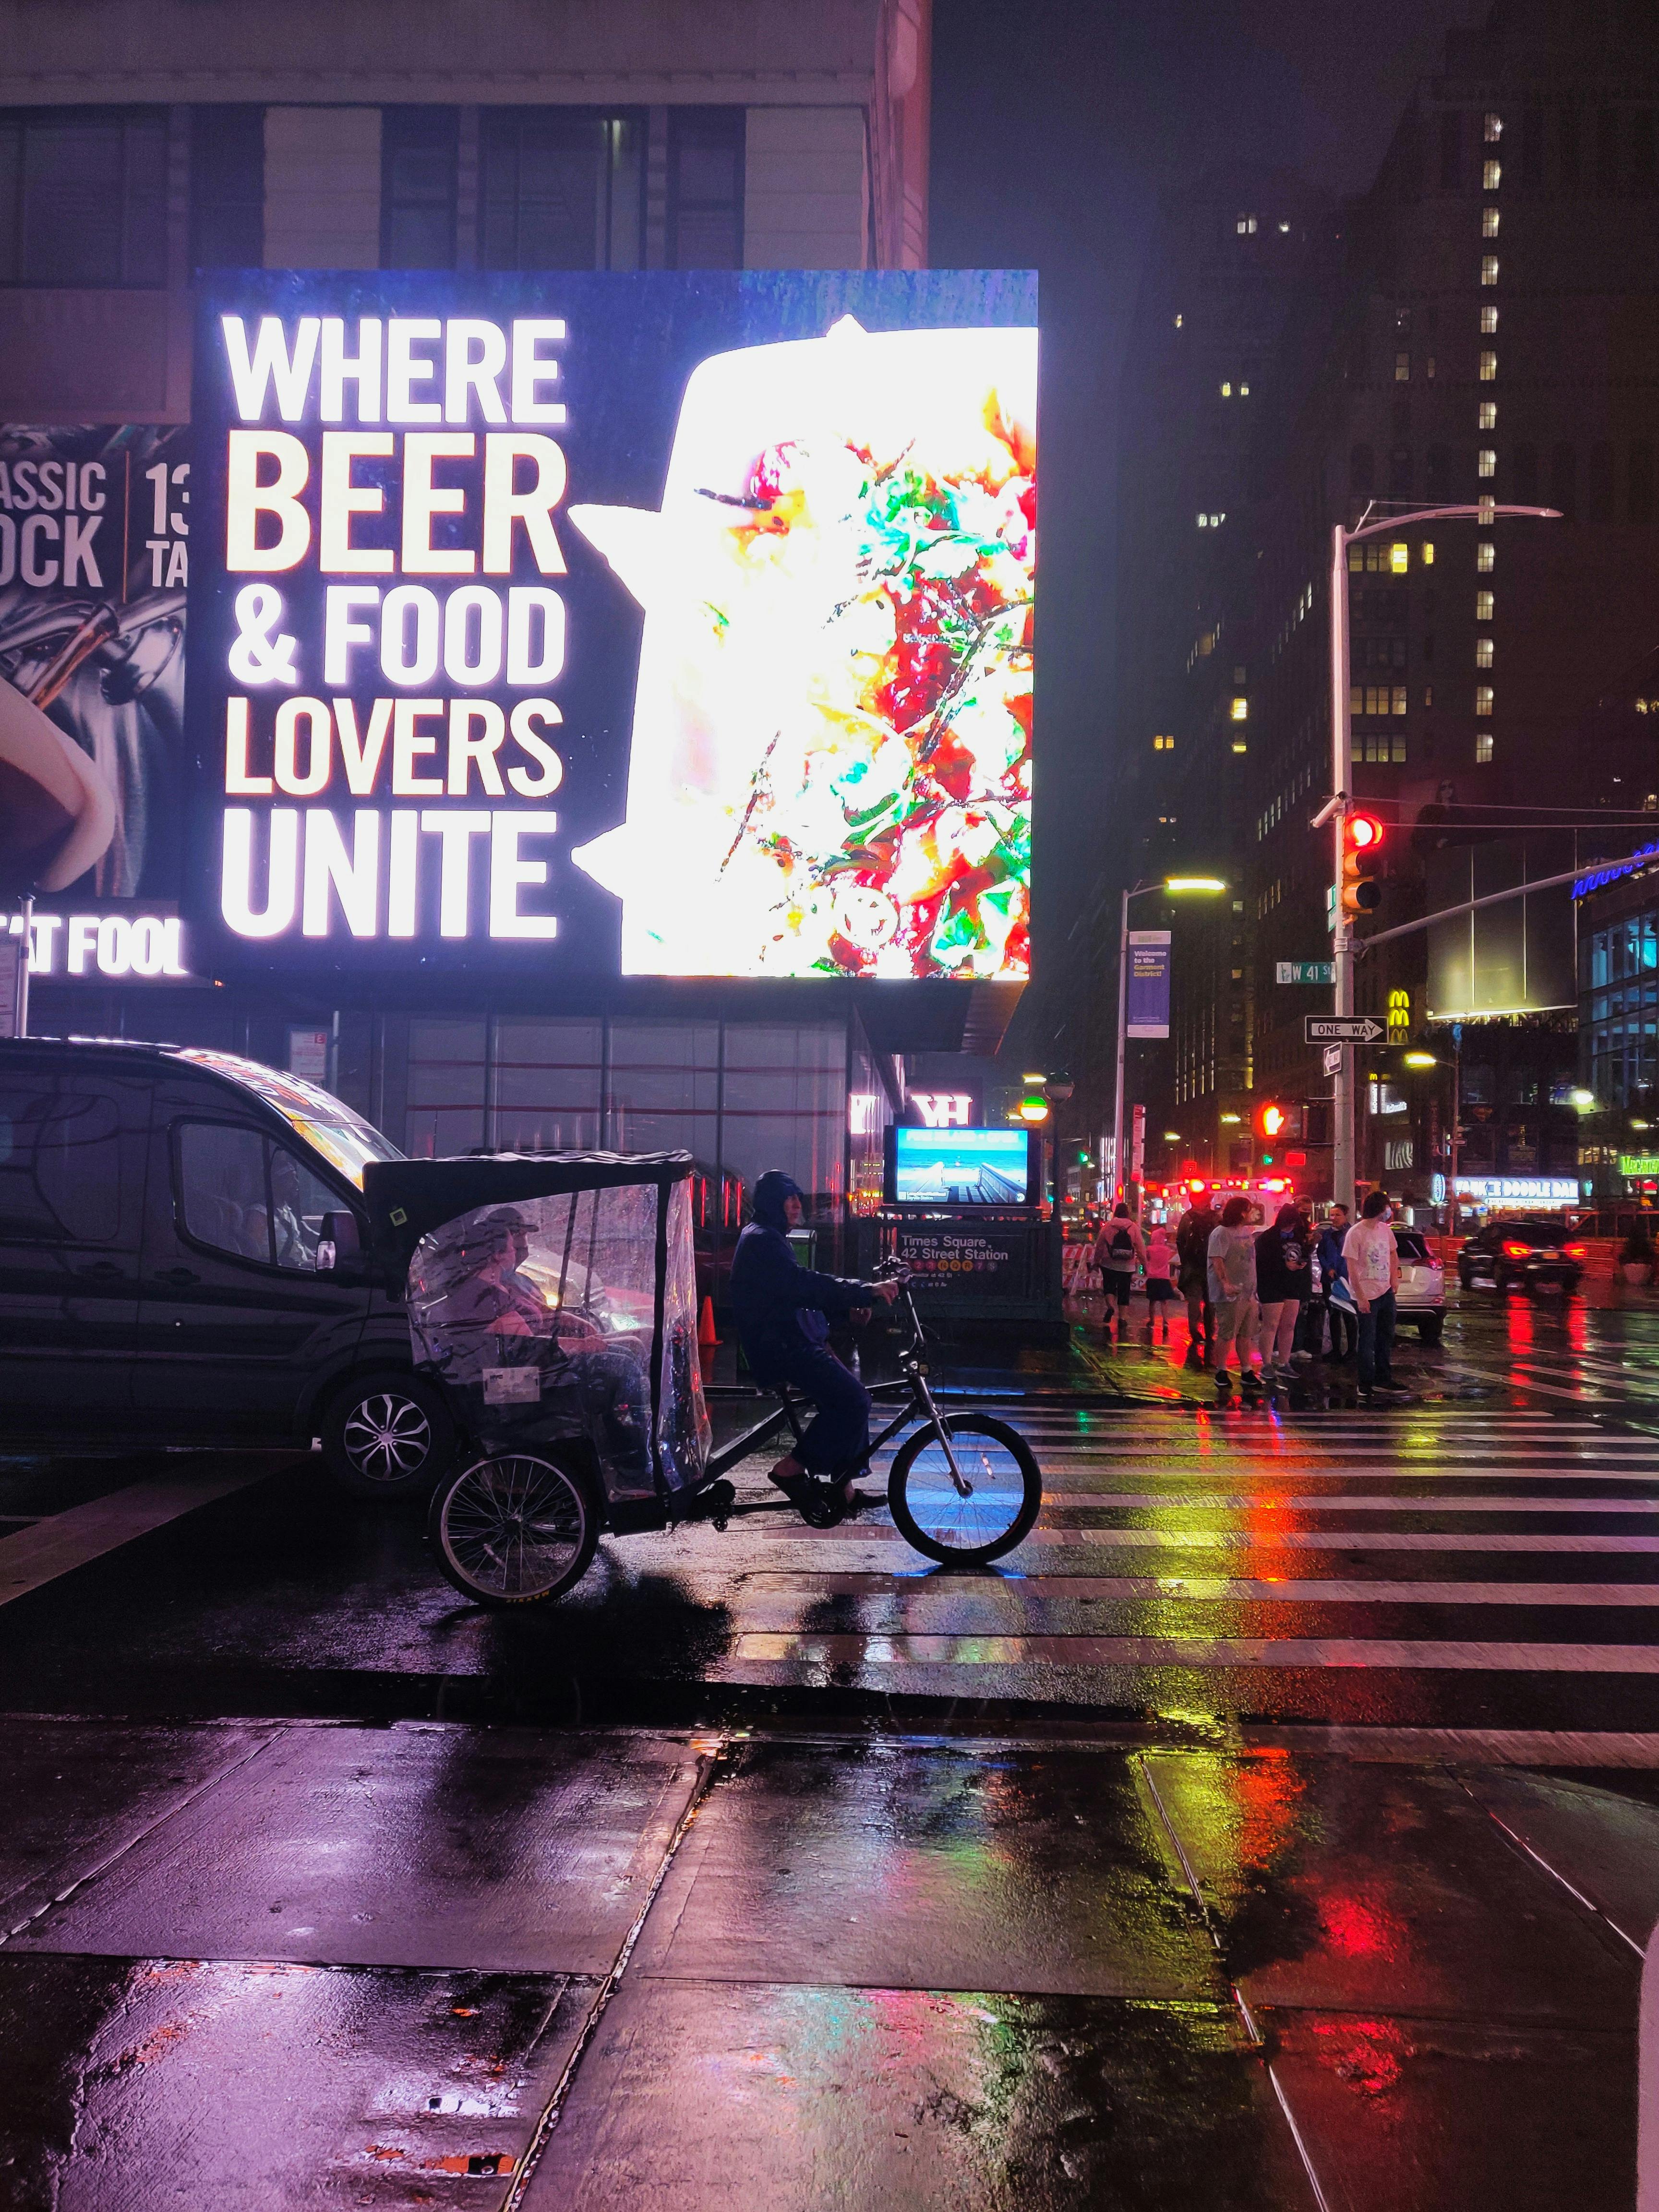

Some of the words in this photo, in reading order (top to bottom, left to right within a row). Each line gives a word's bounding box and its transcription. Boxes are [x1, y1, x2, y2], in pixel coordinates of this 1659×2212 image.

[222, 317, 566, 423] WHERE
[226, 430, 567, 574] BEER
[228, 583, 297, 685] &
[324, 585, 565, 685] FOOD
[225, 697, 563, 797] LOVERS
[221, 808, 557, 938] UNITE
[1292, 965, 1301, 980] W
[1306, 965, 1318, 980] 41
[1318, 1025, 1341, 1034] ONE
[1352, 1025, 1375, 1035] WAY
[1503, 1181, 1551, 1197] DOODLE
[901, 1236, 938, 1246] Times
[902, 1248, 917, 1259] 42
[922, 1248, 960, 1259] Street
[964, 1249, 1008, 1260] Station
